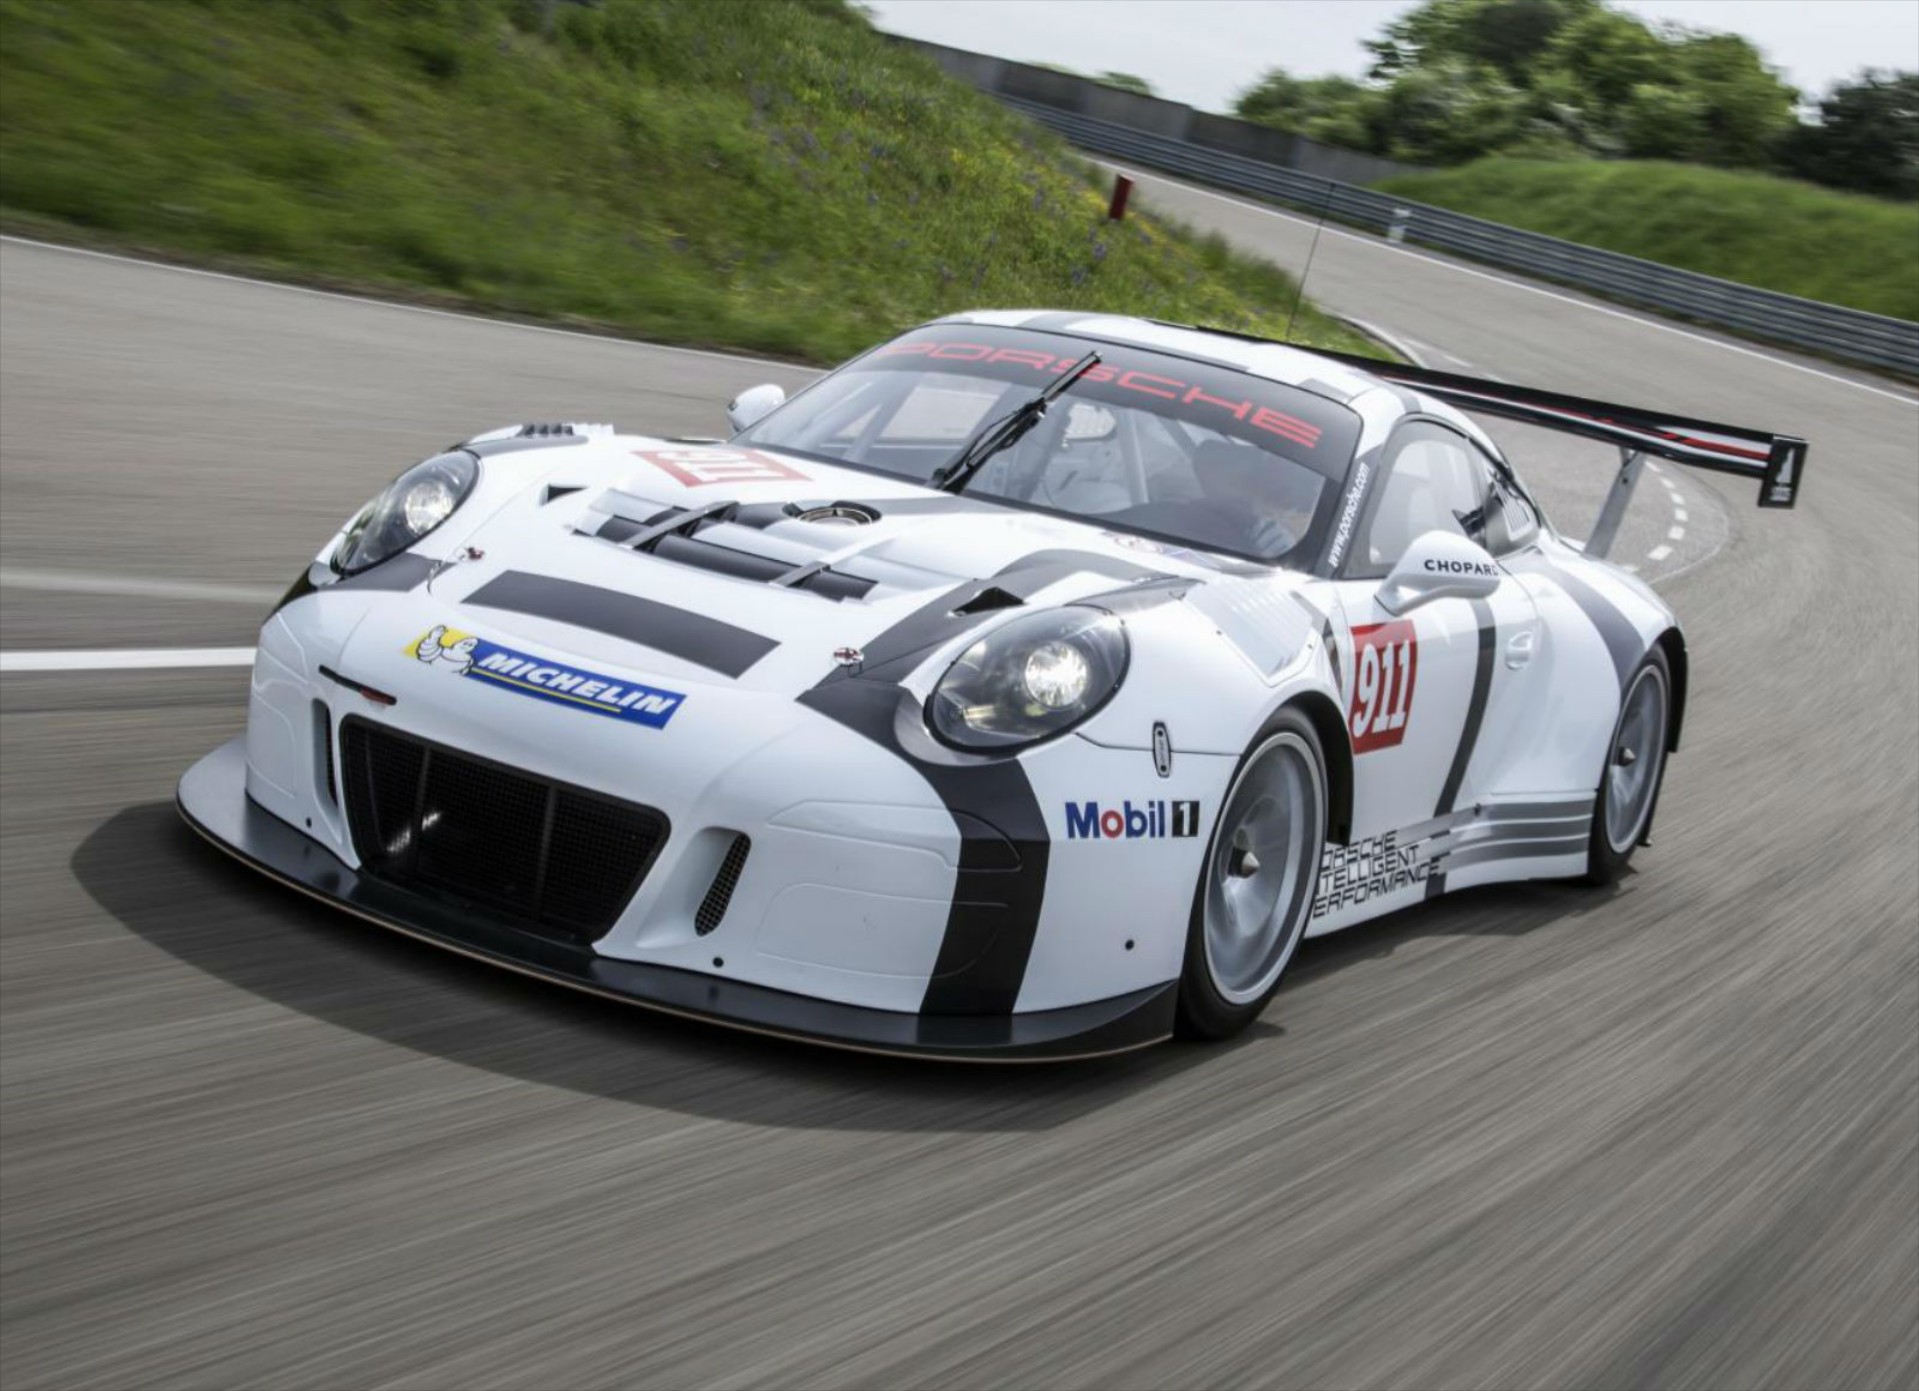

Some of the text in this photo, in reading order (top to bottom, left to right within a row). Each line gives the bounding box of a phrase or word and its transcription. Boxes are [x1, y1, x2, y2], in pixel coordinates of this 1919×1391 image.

[878, 341, 1323, 450] PORSCHE
[1327, 462, 1369, 568] www.porsche.com
[478, 651, 677, 715] MICHELIN
[1353, 639, 1410, 738] 911
[1065, 800, 1195, 839] Mobil 1
[1321, 829, 1398, 870] ORSCHE
[1312, 855, 1443, 919] ERFORMANCE
[1319, 845, 1419, 896] TELLIGENT
